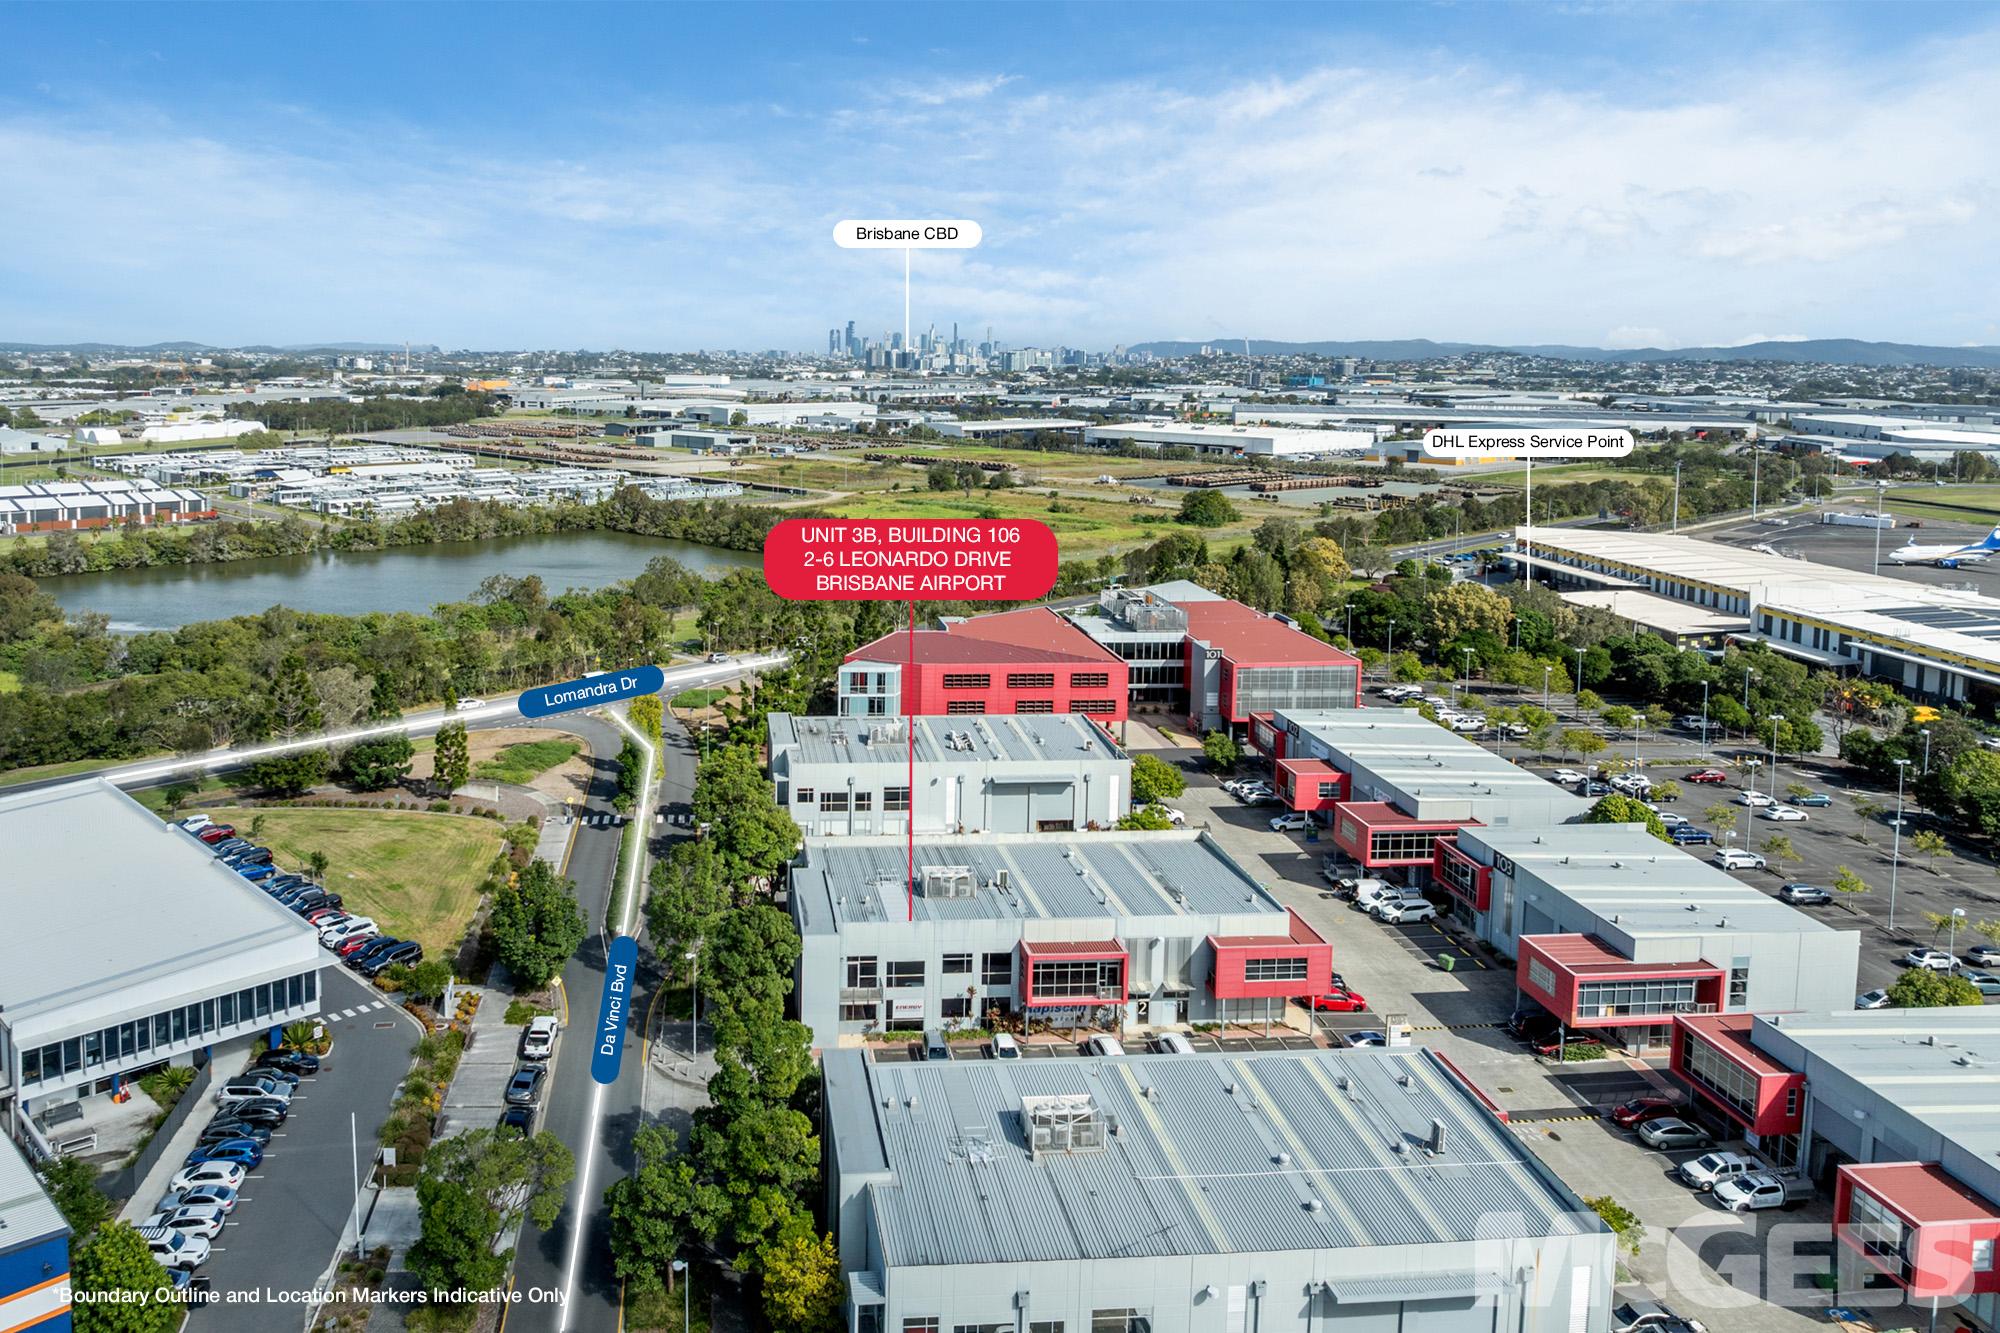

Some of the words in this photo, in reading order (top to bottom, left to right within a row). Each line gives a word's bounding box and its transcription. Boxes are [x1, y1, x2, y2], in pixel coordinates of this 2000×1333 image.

[1206, 650, 1221, 659] 101
[1289, 721, 1299, 737] 102
[1496, 854, 1512, 876] 103
[1138, 1001, 1148, 1015] 2
[1177, 1000, 1184, 1013] 1
